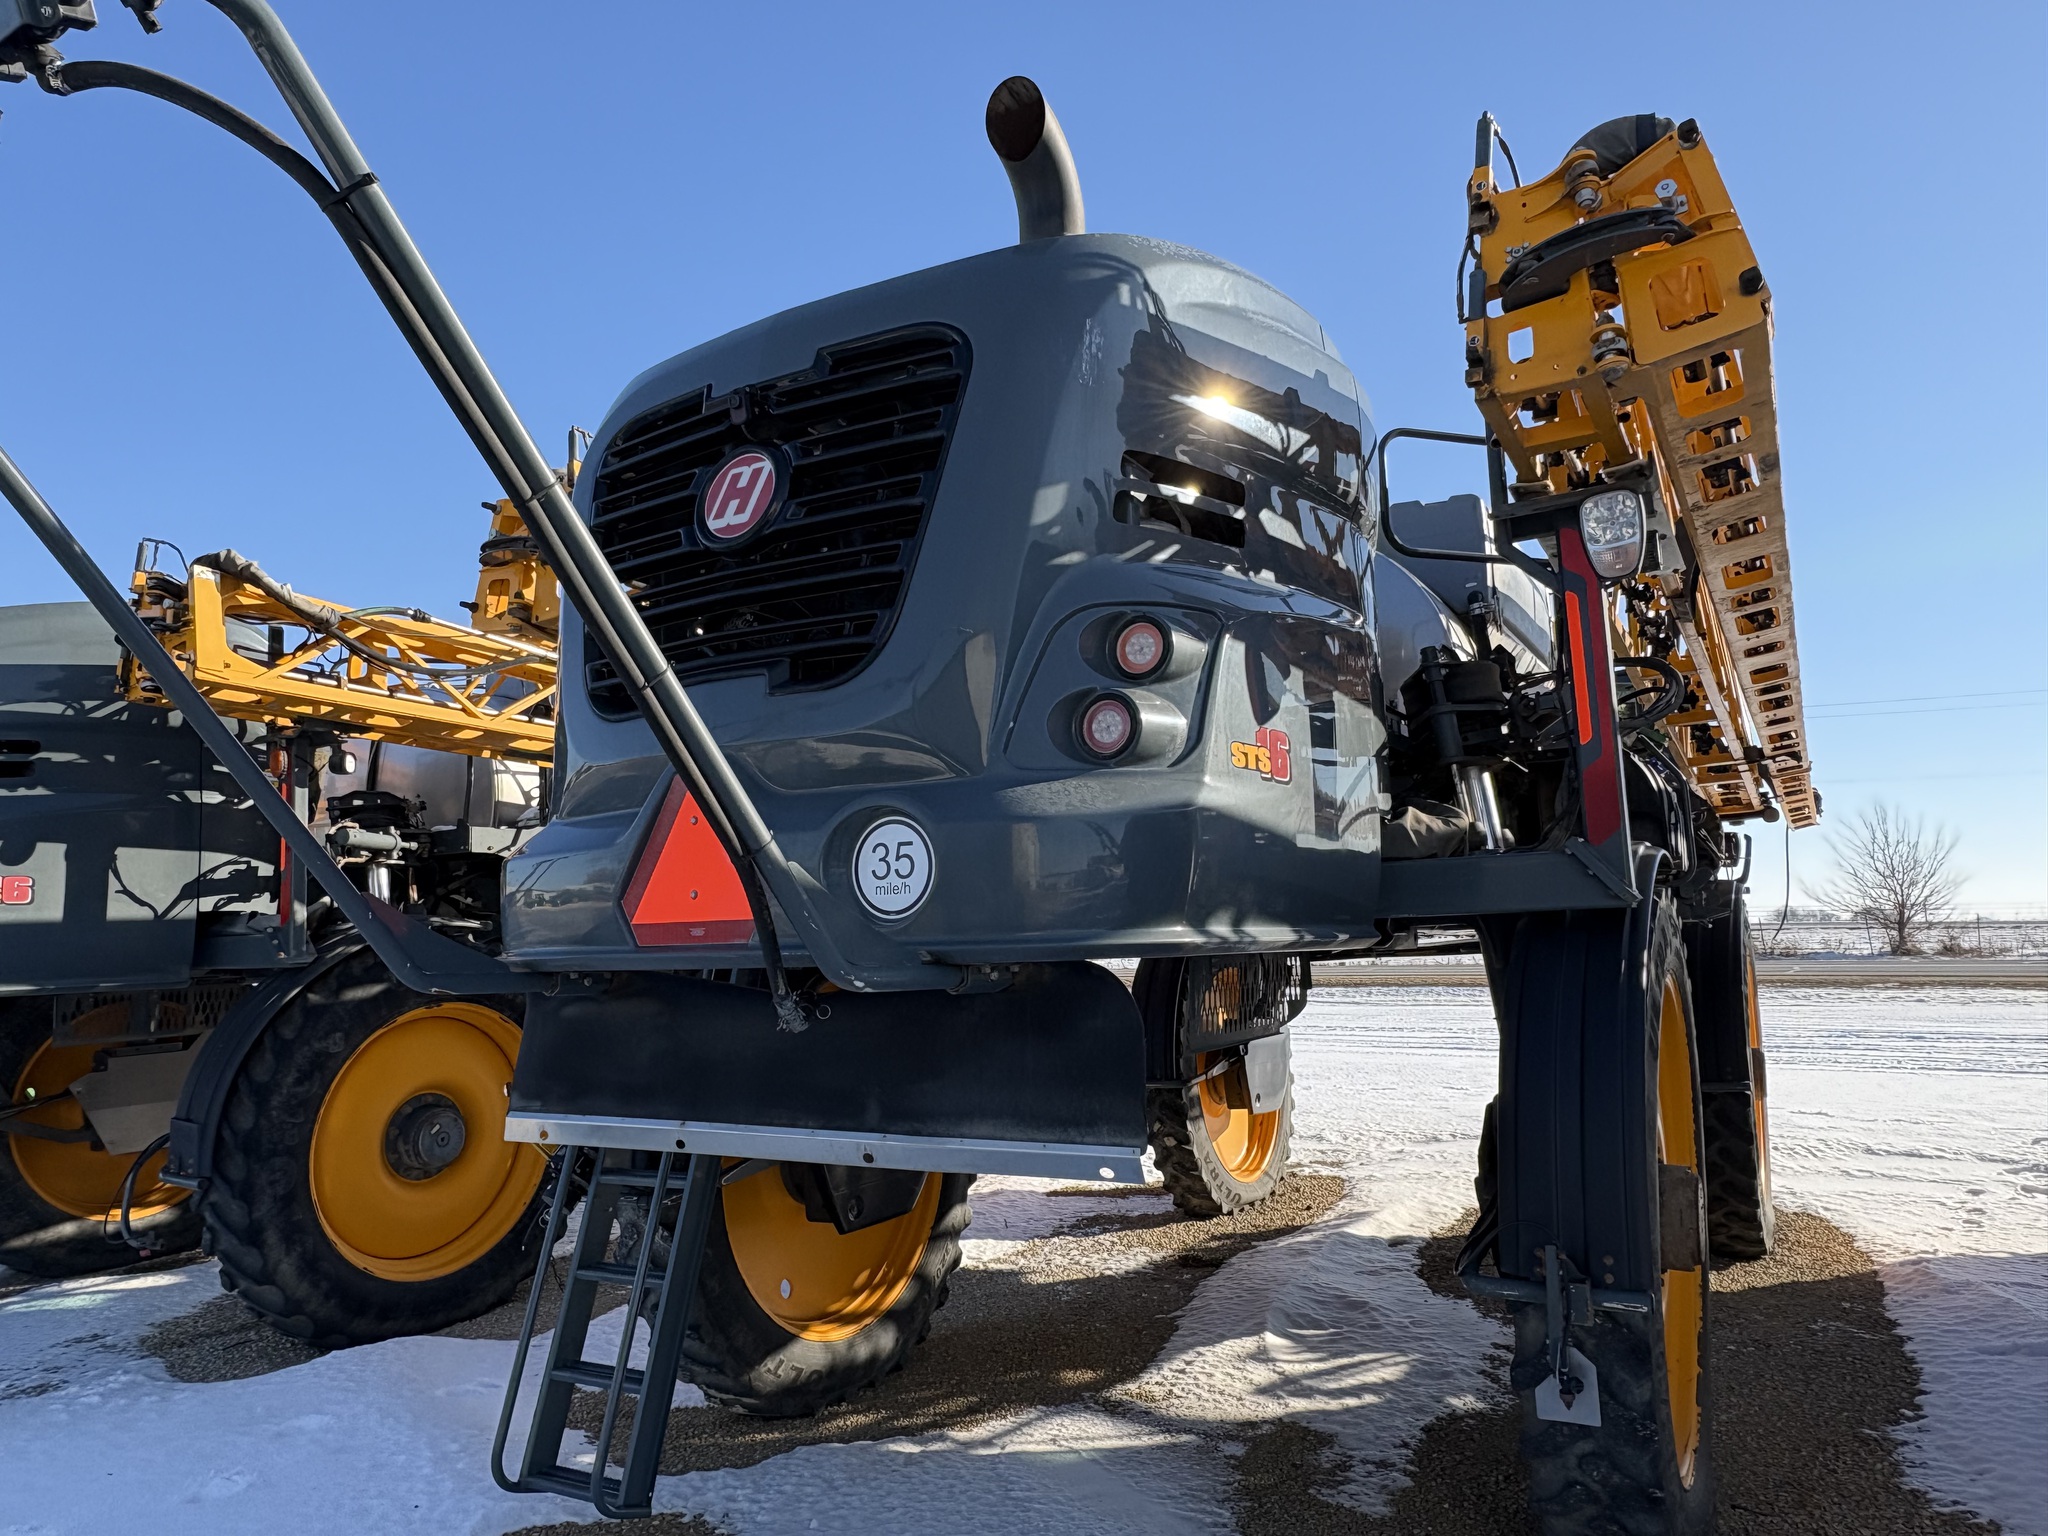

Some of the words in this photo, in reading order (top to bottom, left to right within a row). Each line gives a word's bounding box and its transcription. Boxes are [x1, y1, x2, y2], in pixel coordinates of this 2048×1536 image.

[1230, 740, 1272, 773] STS
[871, 840, 916, 881] 35
[875, 881, 911, 896] mile/h
[1203, 1150, 1243, 1206] ULTRA
